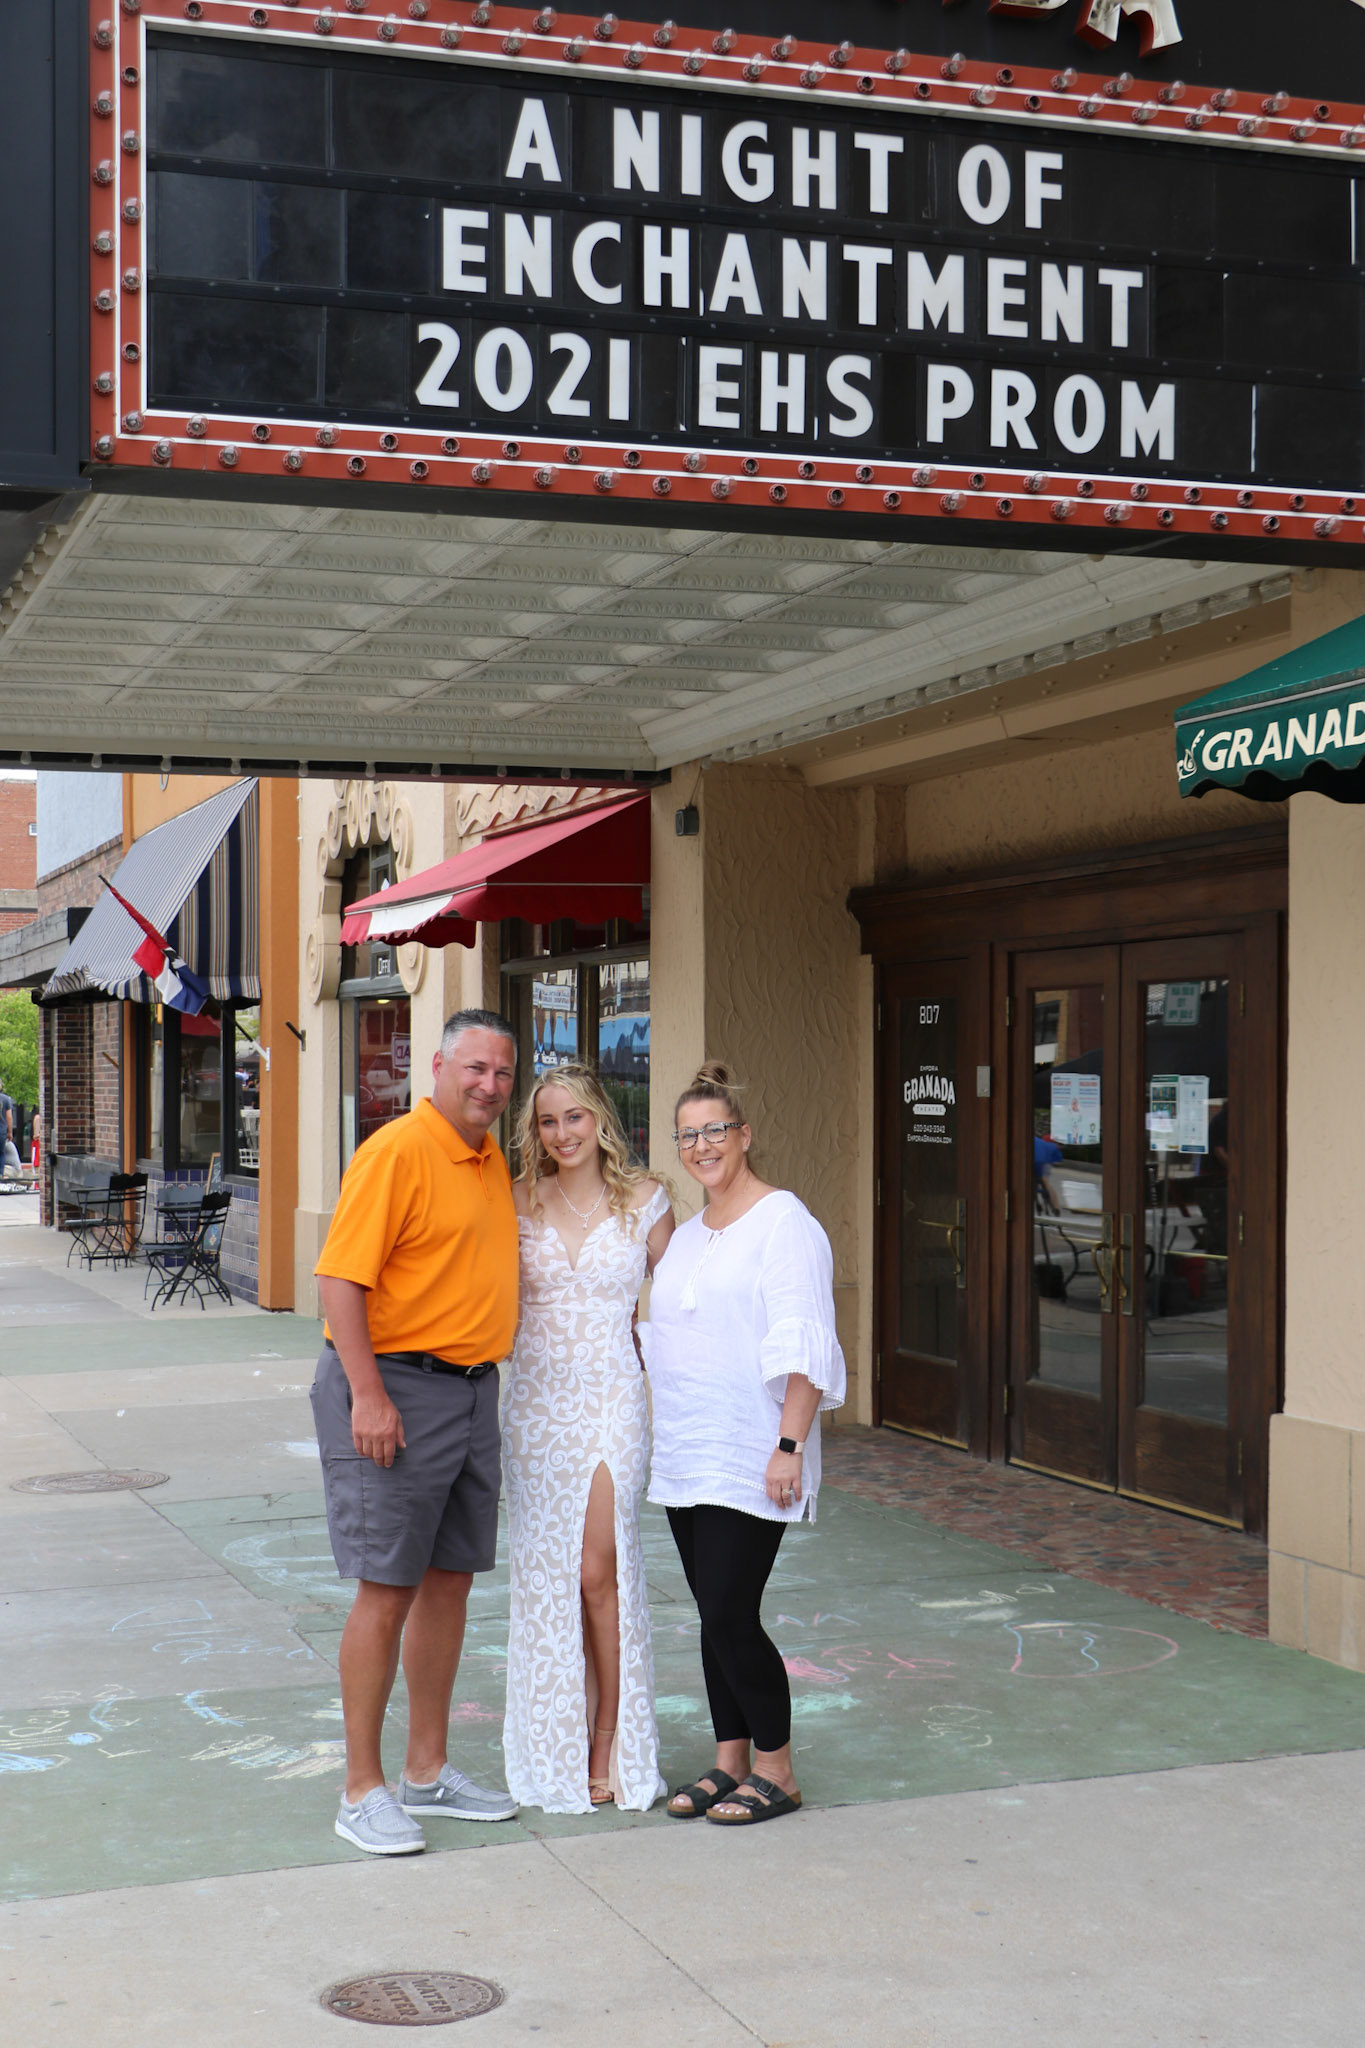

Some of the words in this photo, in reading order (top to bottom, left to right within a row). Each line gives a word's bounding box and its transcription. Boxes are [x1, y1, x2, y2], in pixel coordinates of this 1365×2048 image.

[505, 98, 562, 182] A
[613, 108, 904, 214] NIGHT
[957, 144, 1063, 230] OF
[442, 207, 1144, 348] ENCHANTMENT
[415, 322, 630, 421] 2021
[698, 345, 874, 438] EHS
[926, 364, 1175, 461] PROM
[1202, 701, 1365, 772] GRANAD
[919, 1005, 940, 1024] 807
[903, 1074, 956, 1105] GRANADA
[916, 1105, 944, 1113] THEATRE
[377, 1980, 420, 2016] METER
[411, 1978, 452, 2013] WATER
